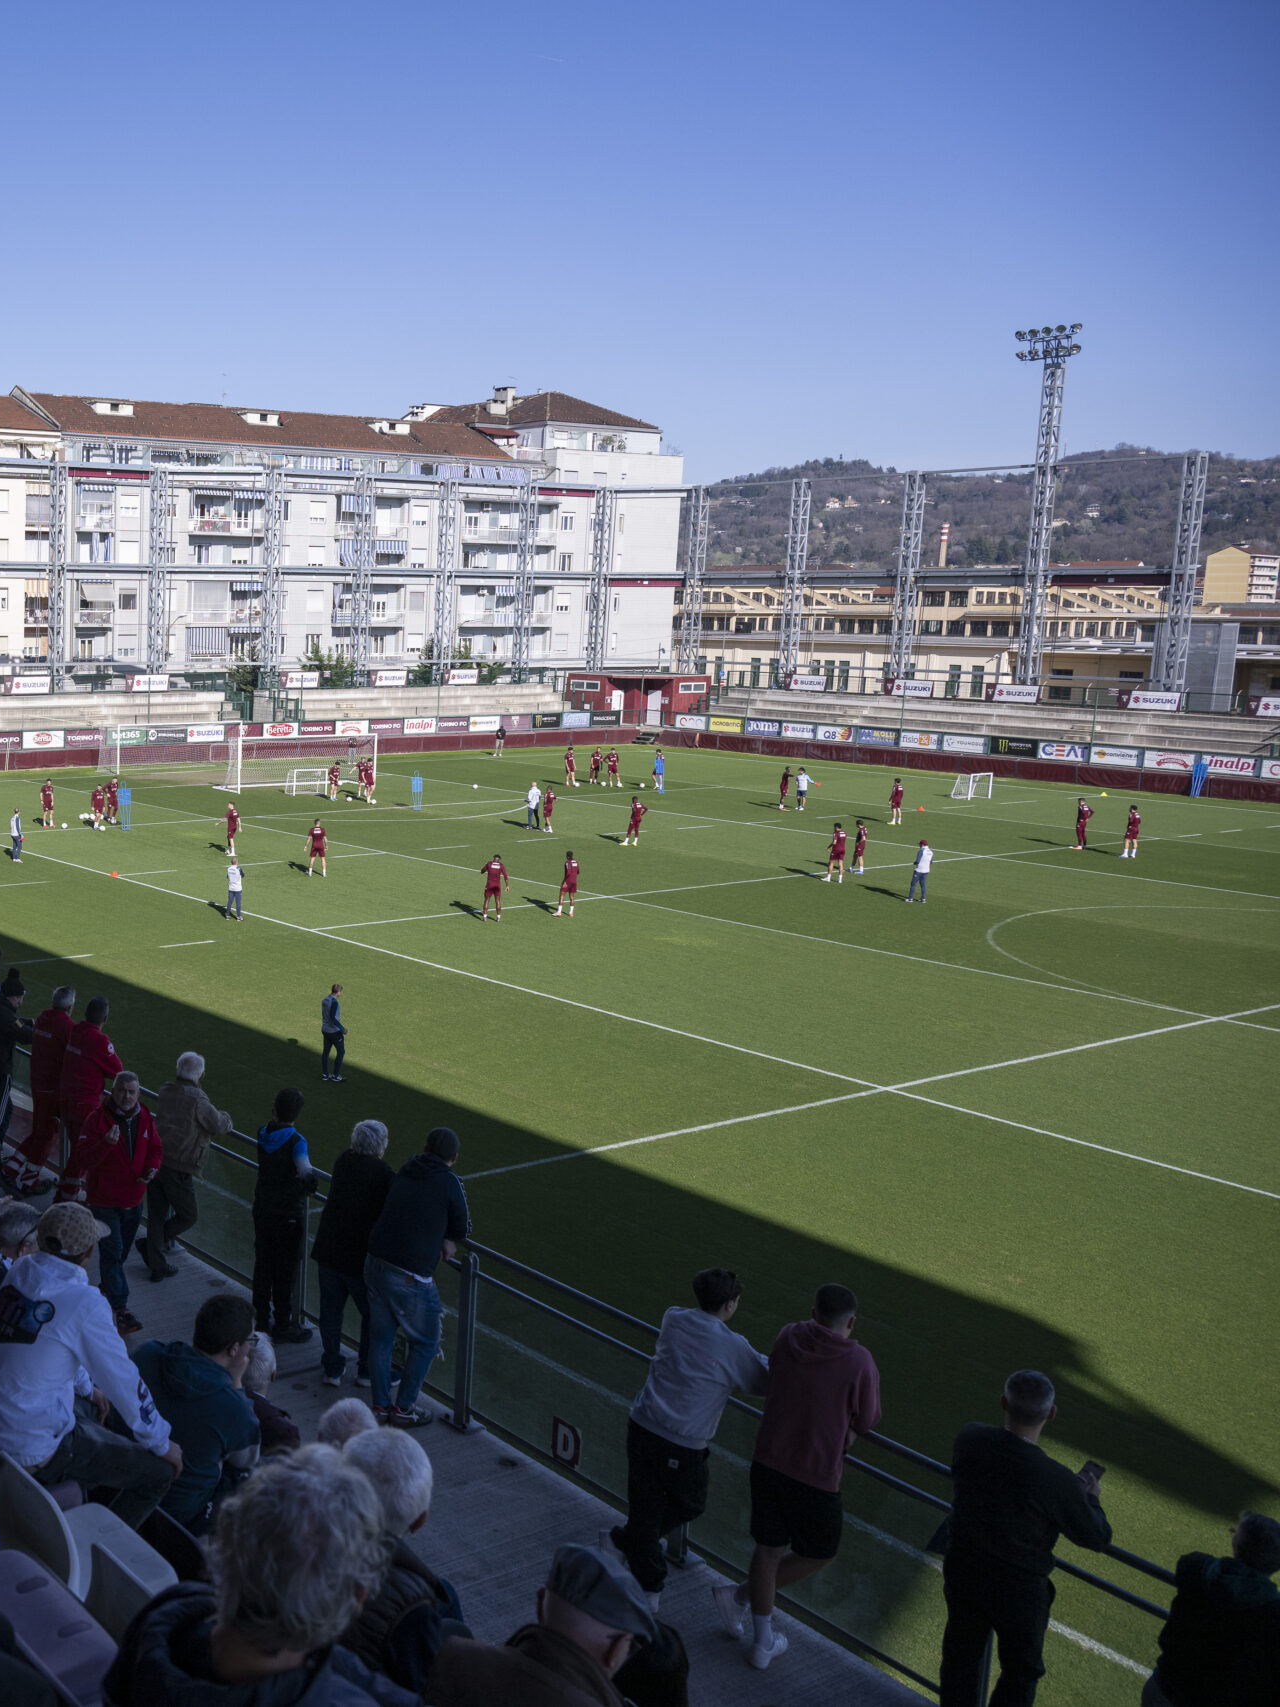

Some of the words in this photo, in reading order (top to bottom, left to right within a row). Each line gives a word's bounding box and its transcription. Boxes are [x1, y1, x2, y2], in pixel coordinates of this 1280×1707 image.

[1005, 690, 1036, 698] SUZUKI
[1142, 697, 1177, 705] SUZUKI
[406, 719, 433, 730] inalpi
[196, 729, 223, 737] SUZUKI
[824, 730, 837, 740] Q8
[1041, 743, 1088, 759] CEAT
[1208, 755, 1258, 772] inalpi
[556, 1422, 576, 1462] D
